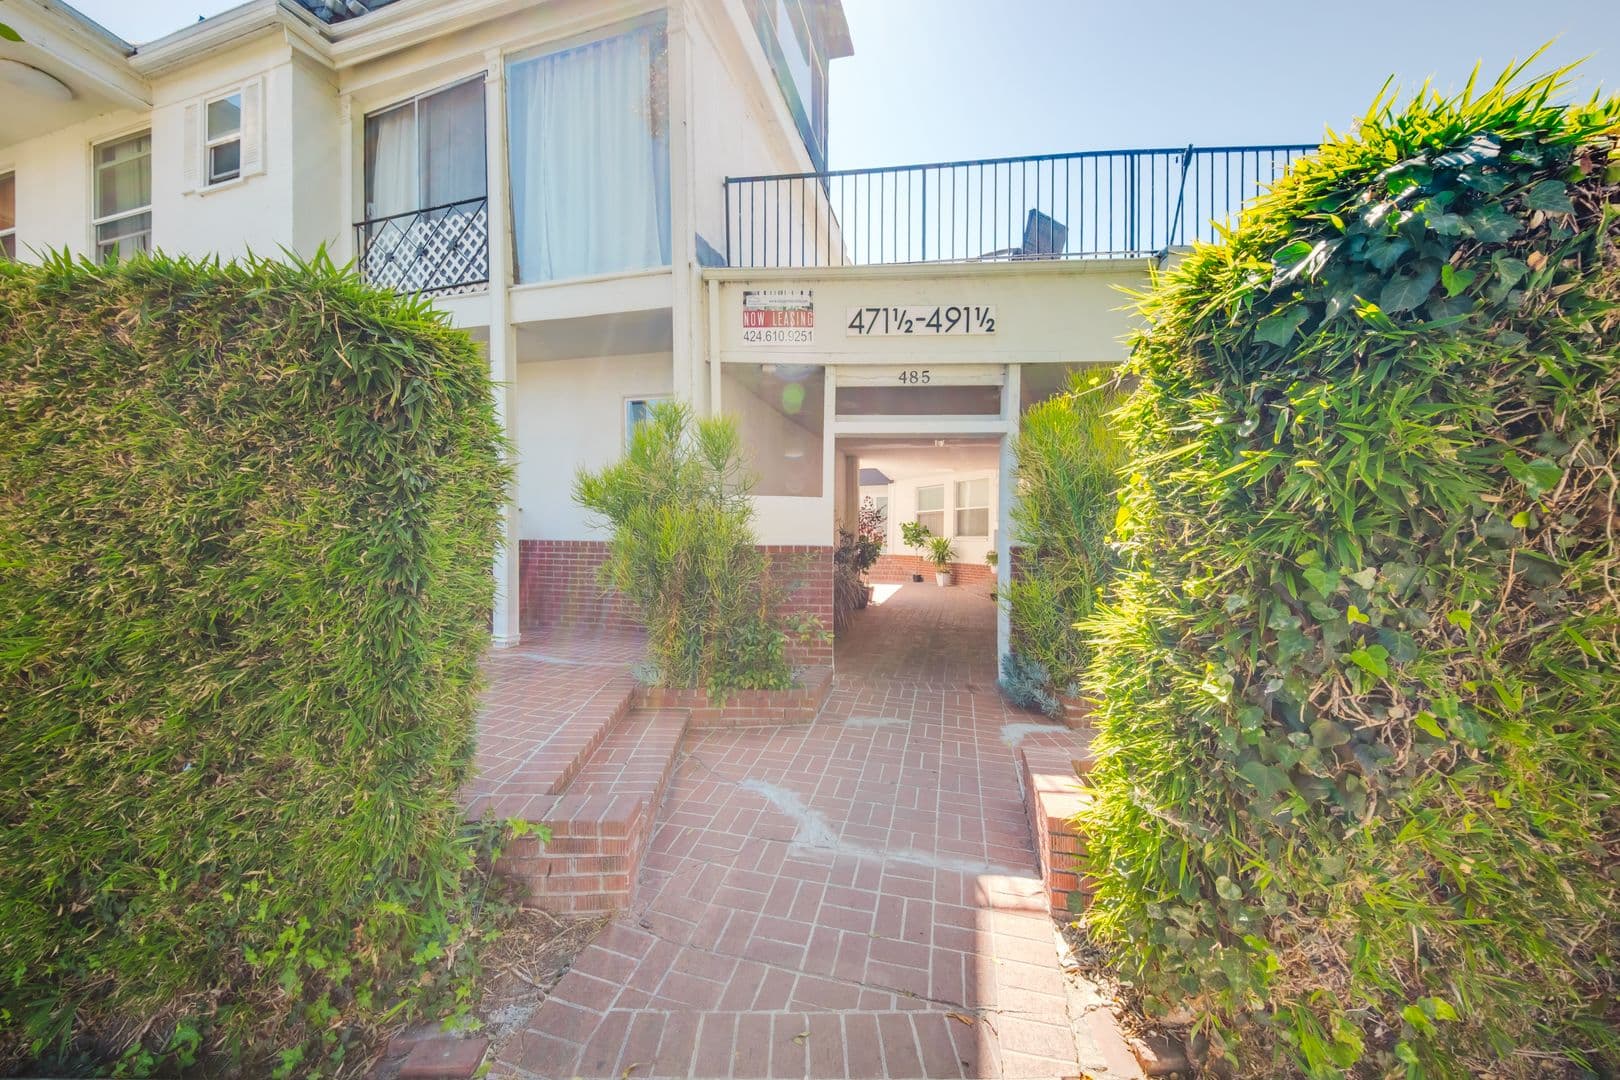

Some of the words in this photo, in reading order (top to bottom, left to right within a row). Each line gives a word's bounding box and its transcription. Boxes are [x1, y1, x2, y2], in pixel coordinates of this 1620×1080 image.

[743, 311, 765, 326] NOW
[772, 311, 814, 326] LEASING
[743, 330, 814, 342] 424.610.9251
[898, 370, 931, 384] 485
